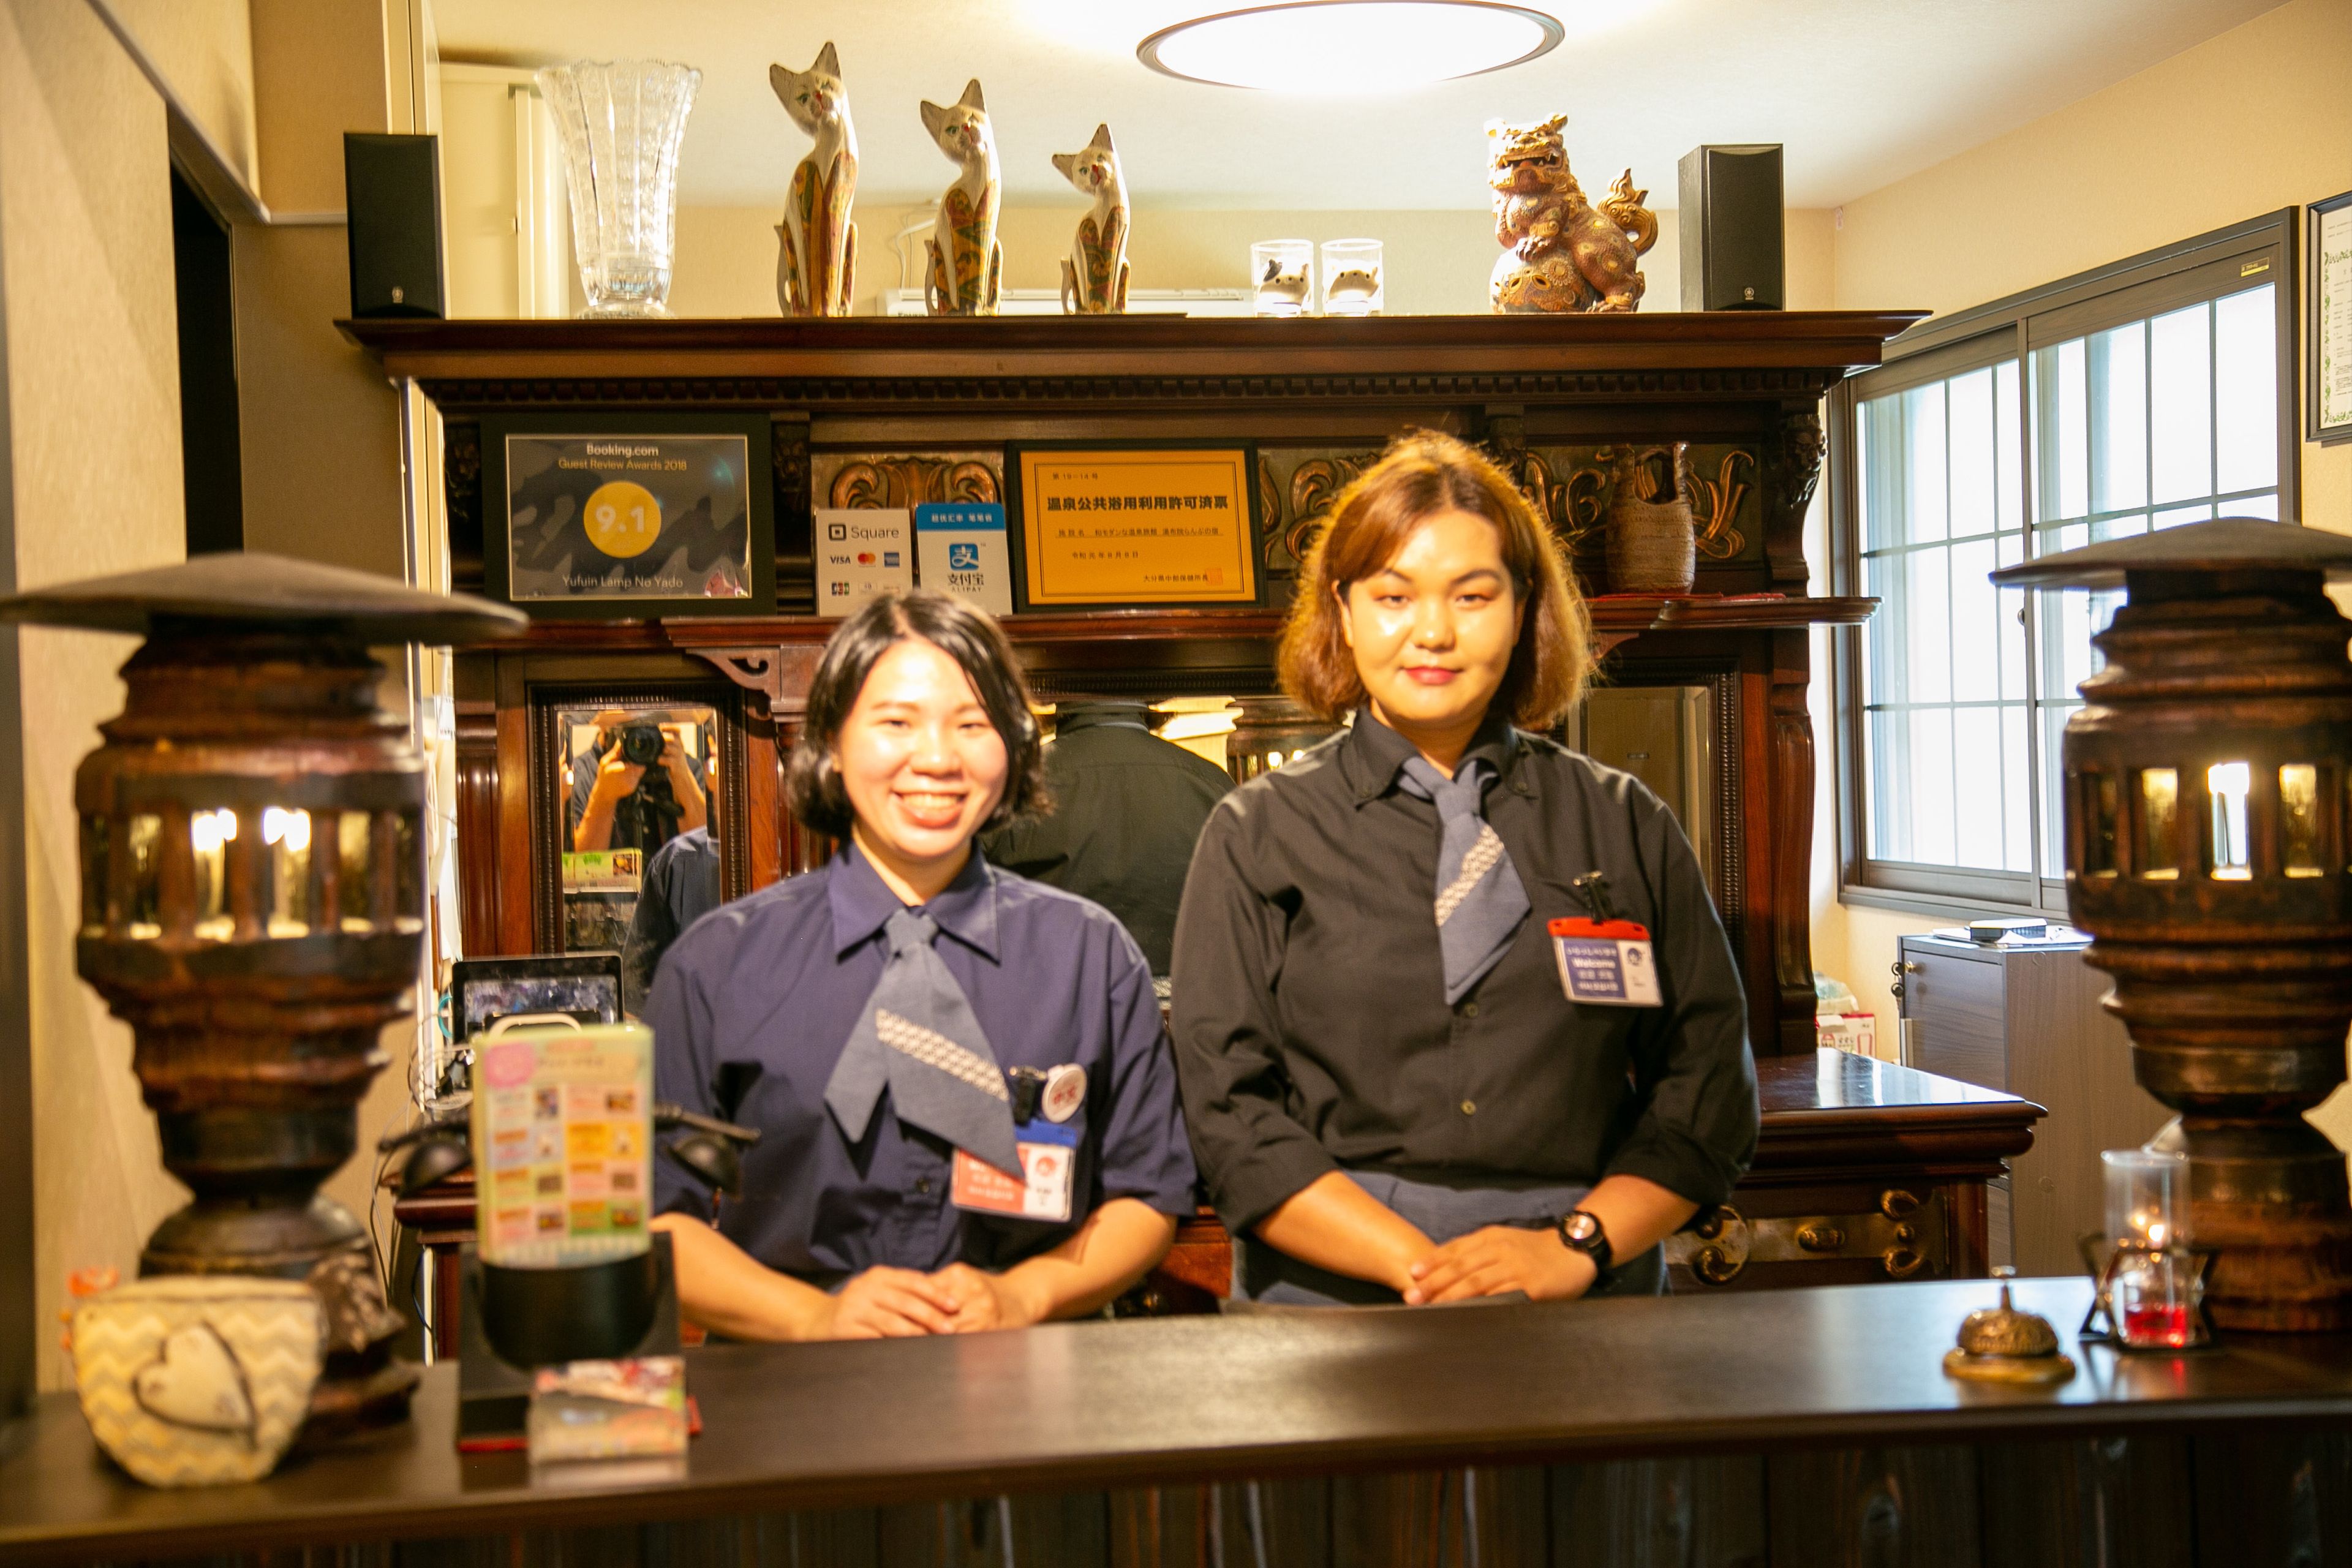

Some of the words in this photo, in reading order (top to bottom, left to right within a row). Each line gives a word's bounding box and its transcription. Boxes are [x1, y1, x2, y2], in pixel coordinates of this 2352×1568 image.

[586, 443, 659, 458] Booking.com
[558, 459, 588, 470] Guest
[590, 459, 624, 470] Review
[627, 459, 662, 470] Awards
[664, 459, 687, 471] 2018
[1047, 495, 1229, 511] 温泉公共浴用利用許可済票
[595, 505, 645, 534] 9.1
[851, 526, 900, 540] Square
[830, 555, 851, 565] VISA
[563, 576, 597, 588] Yufuin
[601, 576, 631, 589] Lamp
[635, 576, 652, 587] No
[654, 575, 684, 588] Yado
[947, 573, 984, 586] 支付宝
